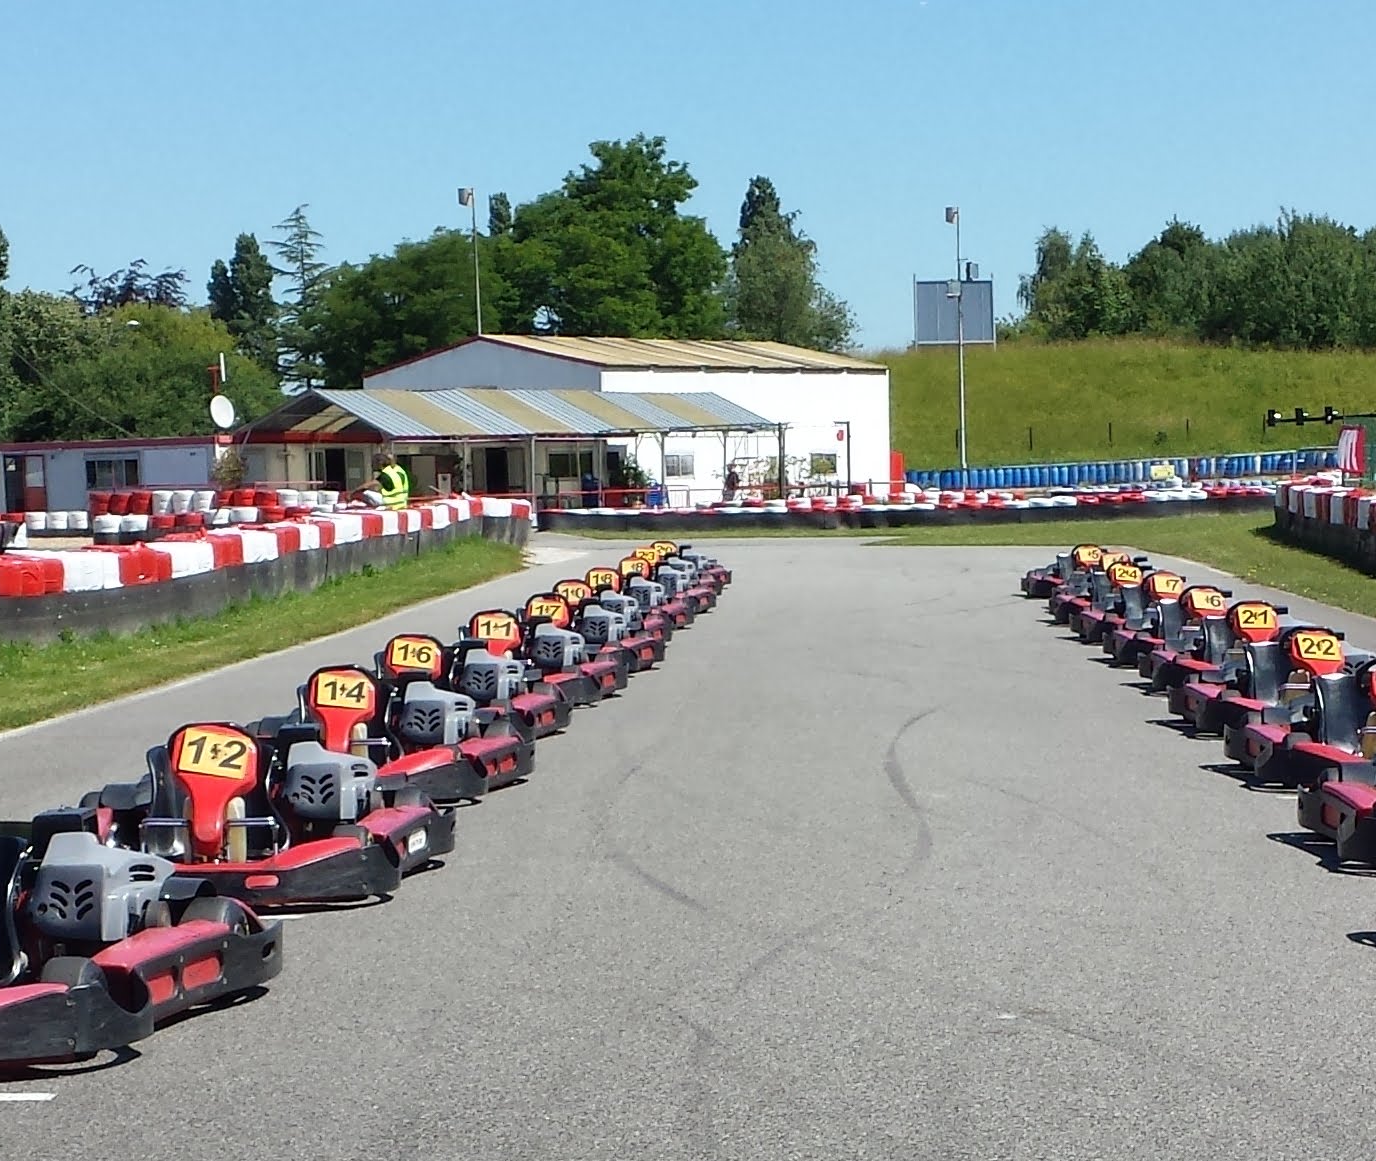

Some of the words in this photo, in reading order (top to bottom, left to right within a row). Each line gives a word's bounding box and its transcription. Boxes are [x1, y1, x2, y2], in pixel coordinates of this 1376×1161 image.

[638, 551, 655, 561] 23
[592, 573, 612, 584] 18
[1118, 568, 1137, 579] 24
[562, 587, 585, 599] 10
[535, 604, 562, 616] 17
[1241, 609, 1268, 625] 21
[480, 620, 512, 637] 11
[398, 643, 432, 664] 16
[1301, 637, 1336, 656] 22
[324, 680, 366, 703] 14
[187, 735, 247, 770] 12
